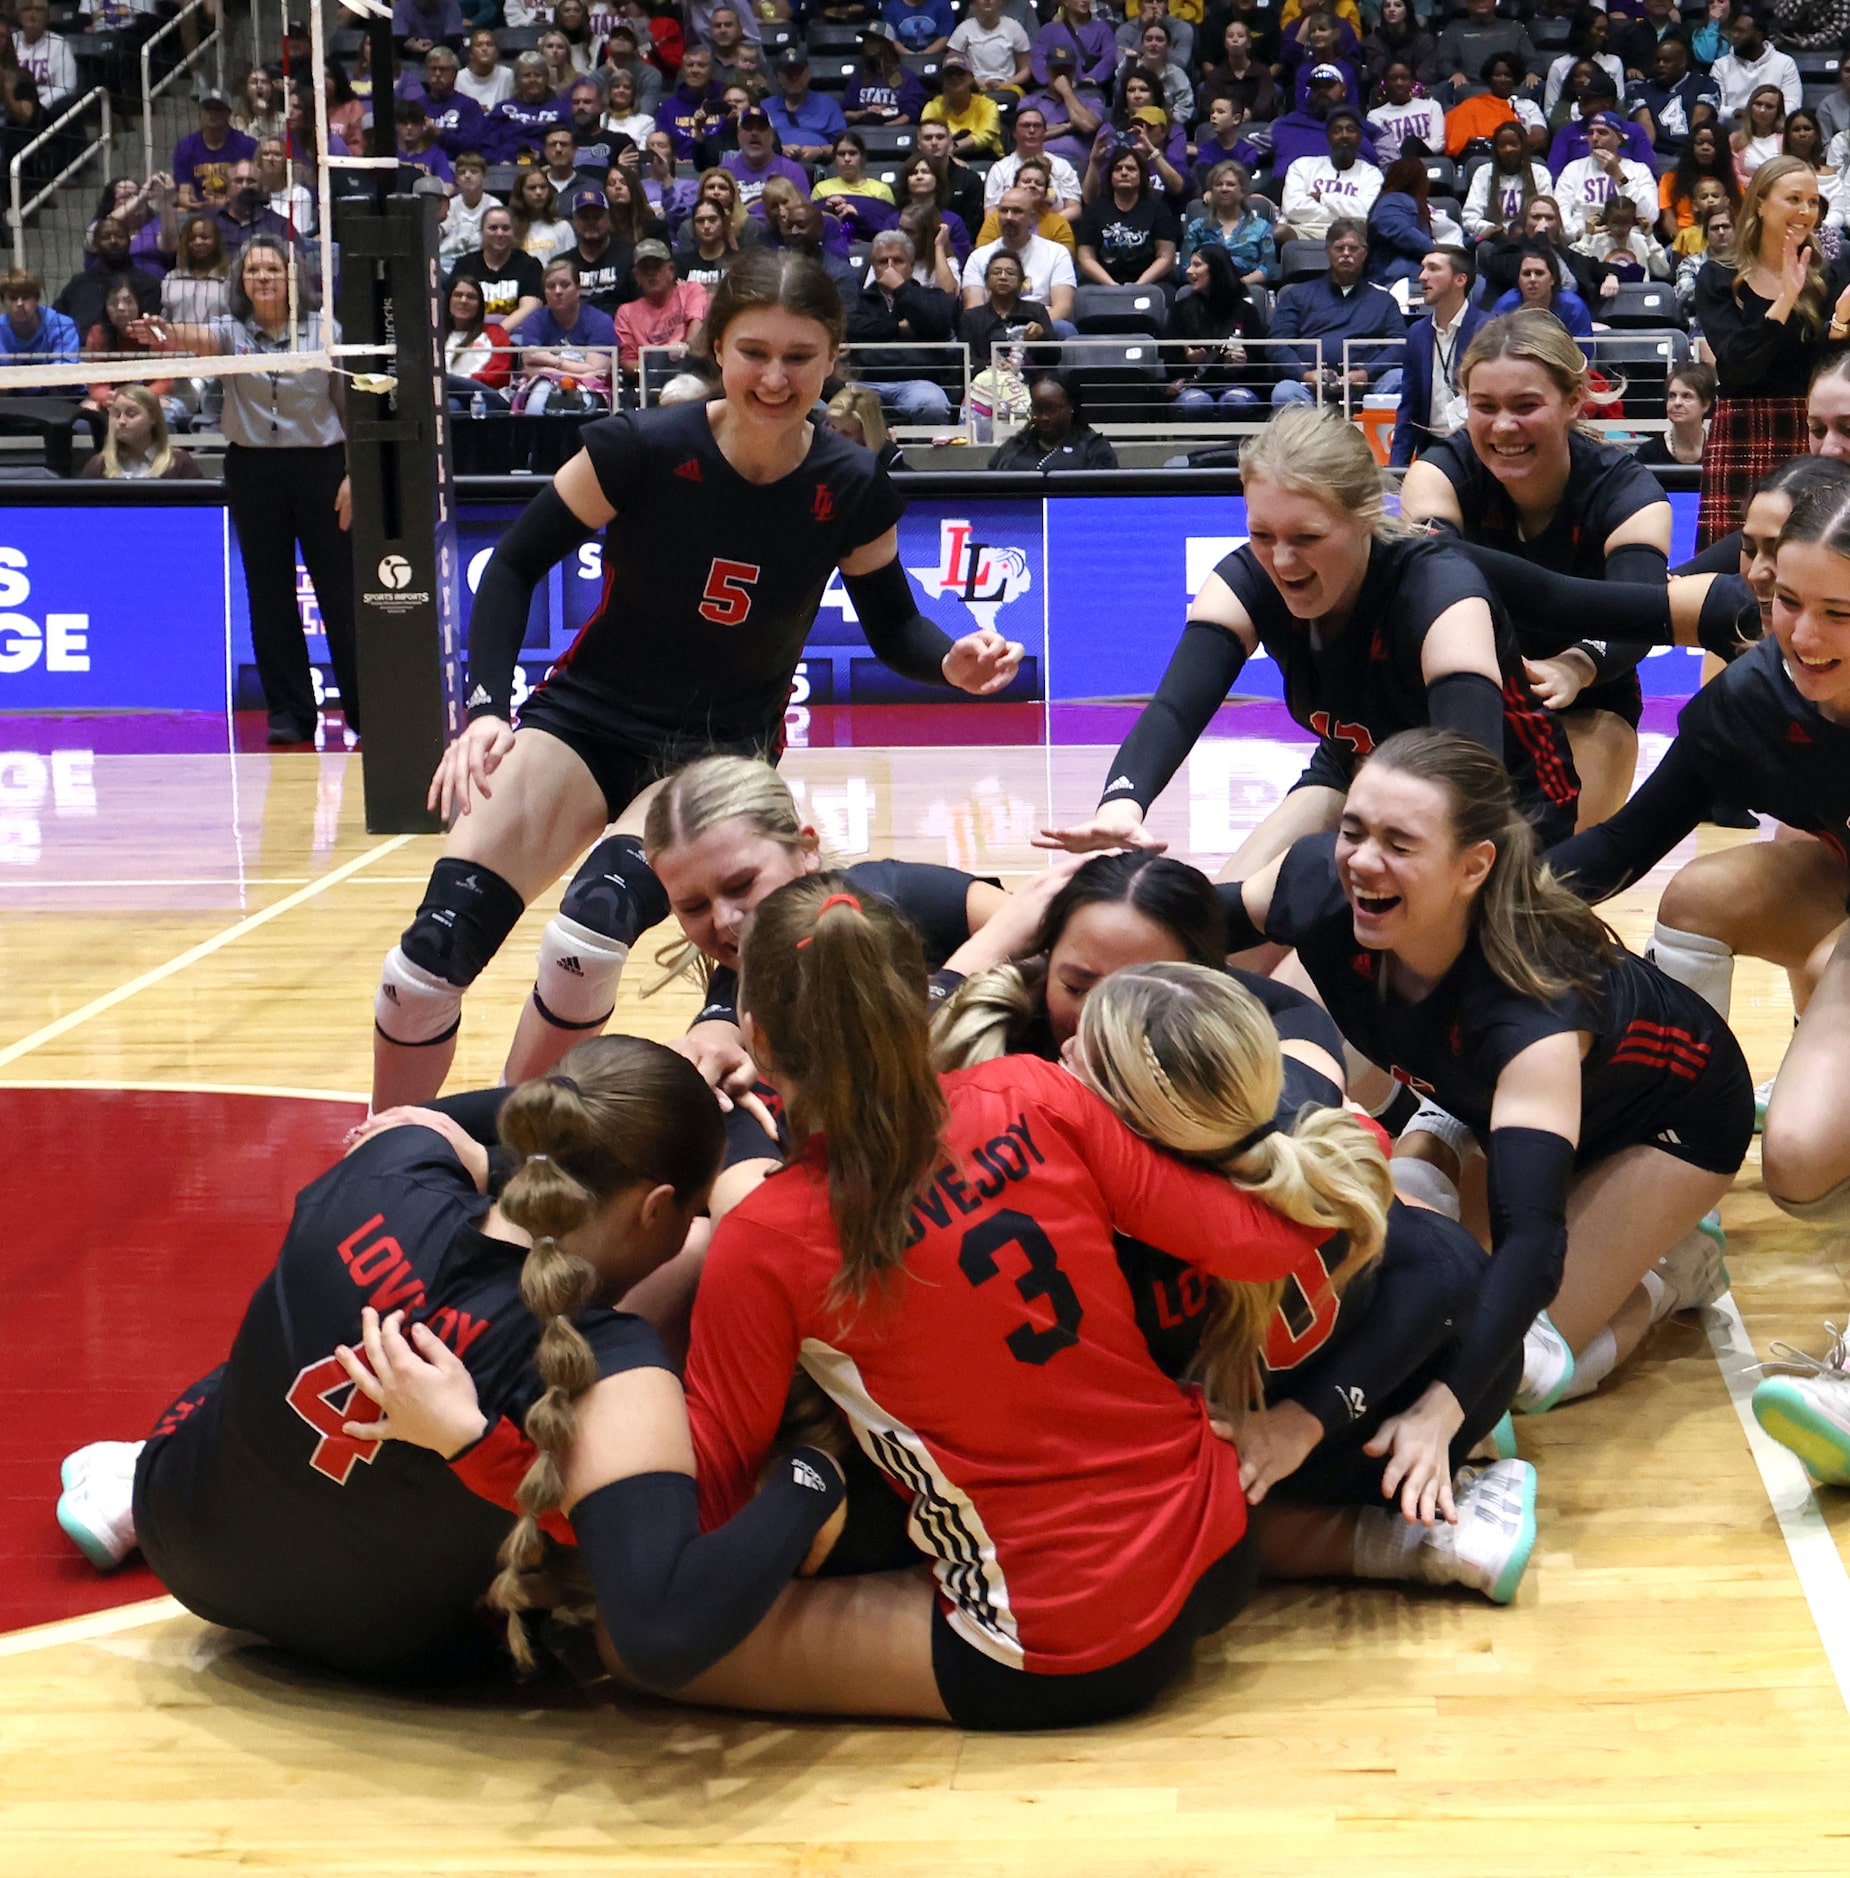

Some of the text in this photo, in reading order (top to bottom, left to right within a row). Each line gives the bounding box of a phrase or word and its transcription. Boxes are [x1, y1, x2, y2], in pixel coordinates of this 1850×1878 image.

[1657, 94, 1689, 136] 4
[698, 557, 761, 626] 5
[899, 1113, 1046, 1250] OVEJOY
[958, 1208, 1084, 1366] 3
[286, 1341, 385, 1486] 4
